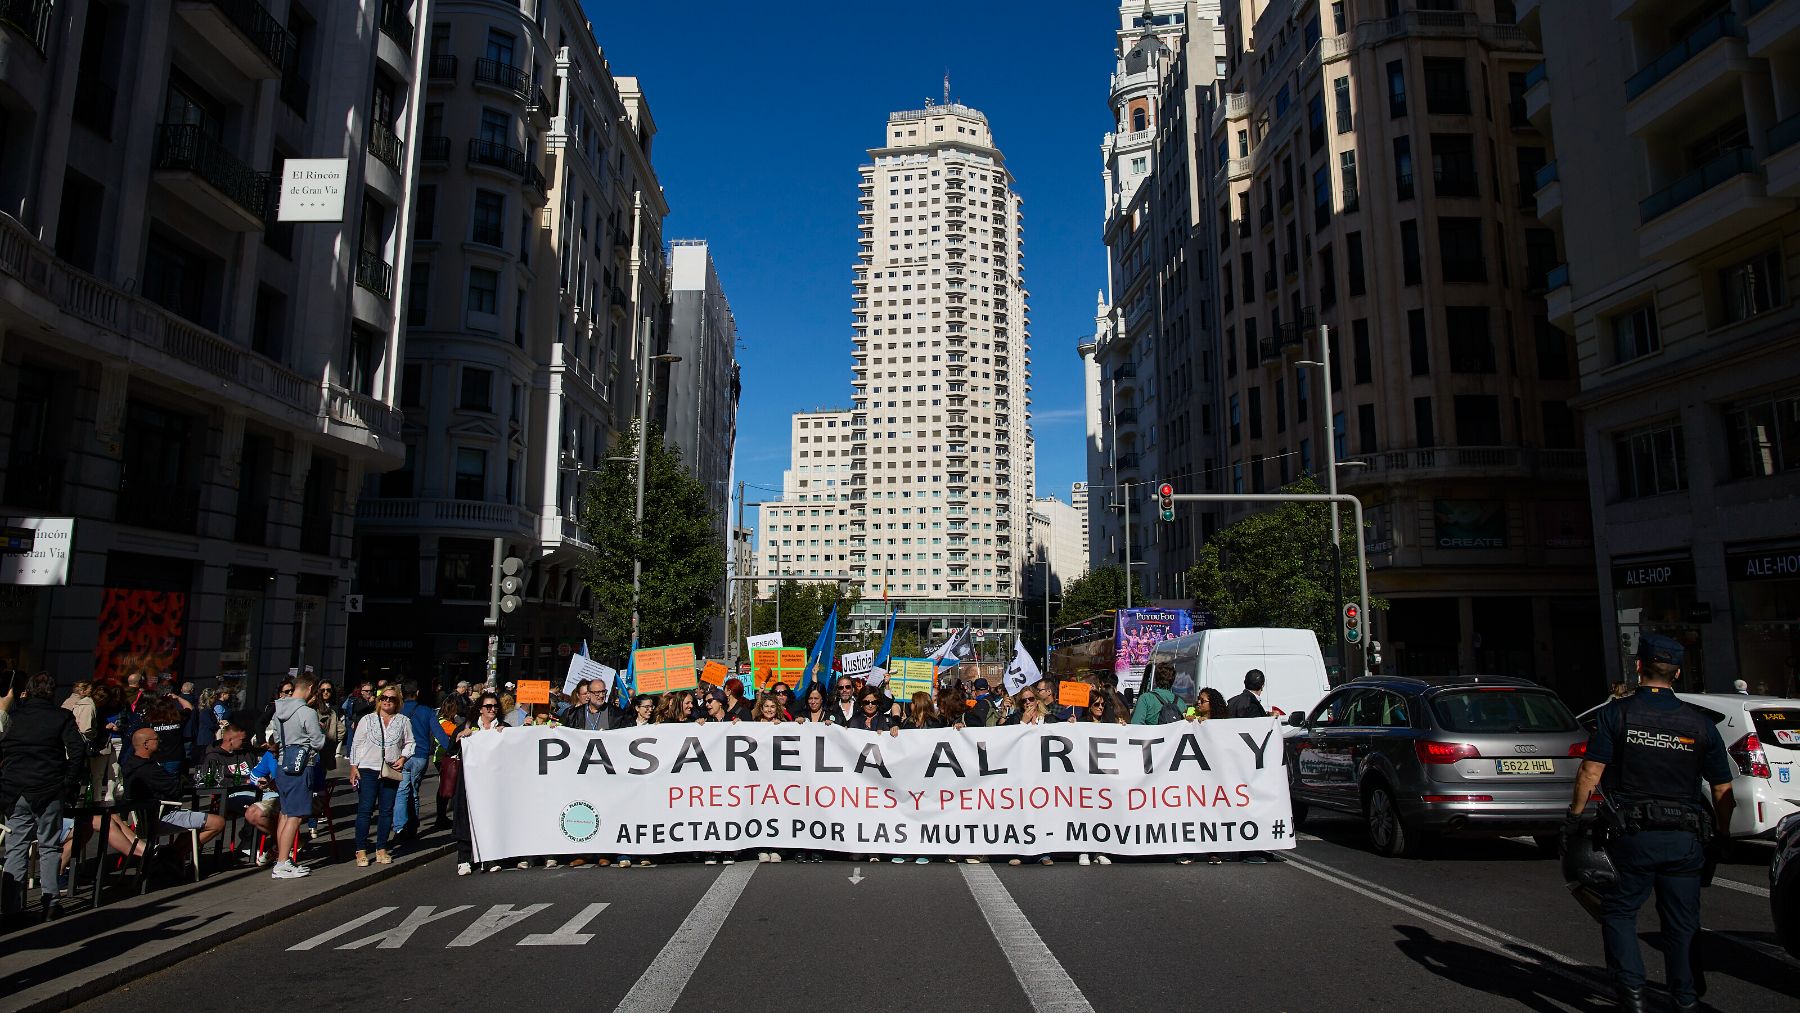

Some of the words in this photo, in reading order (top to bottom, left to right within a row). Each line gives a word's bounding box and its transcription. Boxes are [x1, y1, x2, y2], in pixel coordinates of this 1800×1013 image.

[293, 171, 303, 179] El
[306, 170, 339, 179] Rincón
[290, 186, 300, 194] de
[302, 186, 322, 194] Gran
[36, 529, 67, 538] incón
[1440, 537, 1503, 547] CREATE
[1626, 567, 1671, 584] ALE-HOP
[1627, 729, 1680, 743] POLICIA
[1626, 736, 1694, 752] NACIONAL
[293, 749, 304, 772] adidas
[539, 735, 893, 779] PASARELA
[924, 741, 1008, 778] AL
[1040, 733, 1212, 775] RETA
[1238, 732, 1273, 770] Y
[1502, 761, 1529, 771] 5622
[1530, 760, 1551, 771] HHL
[668, 783, 898, 811] PRESTACIONES
[909, 789, 926, 811] Y
[939, 784, 1114, 811] PENSIONES
[1127, 783, 1250, 811] DIGNAS
[616, 818, 780, 844] AFECTADOS
[792, 819, 845, 842] POR
[857, 822, 908, 844] LAS
[920, 823, 1036, 845] MUTUAS
[1066, 820, 1259, 845] MOVIMIENTO
